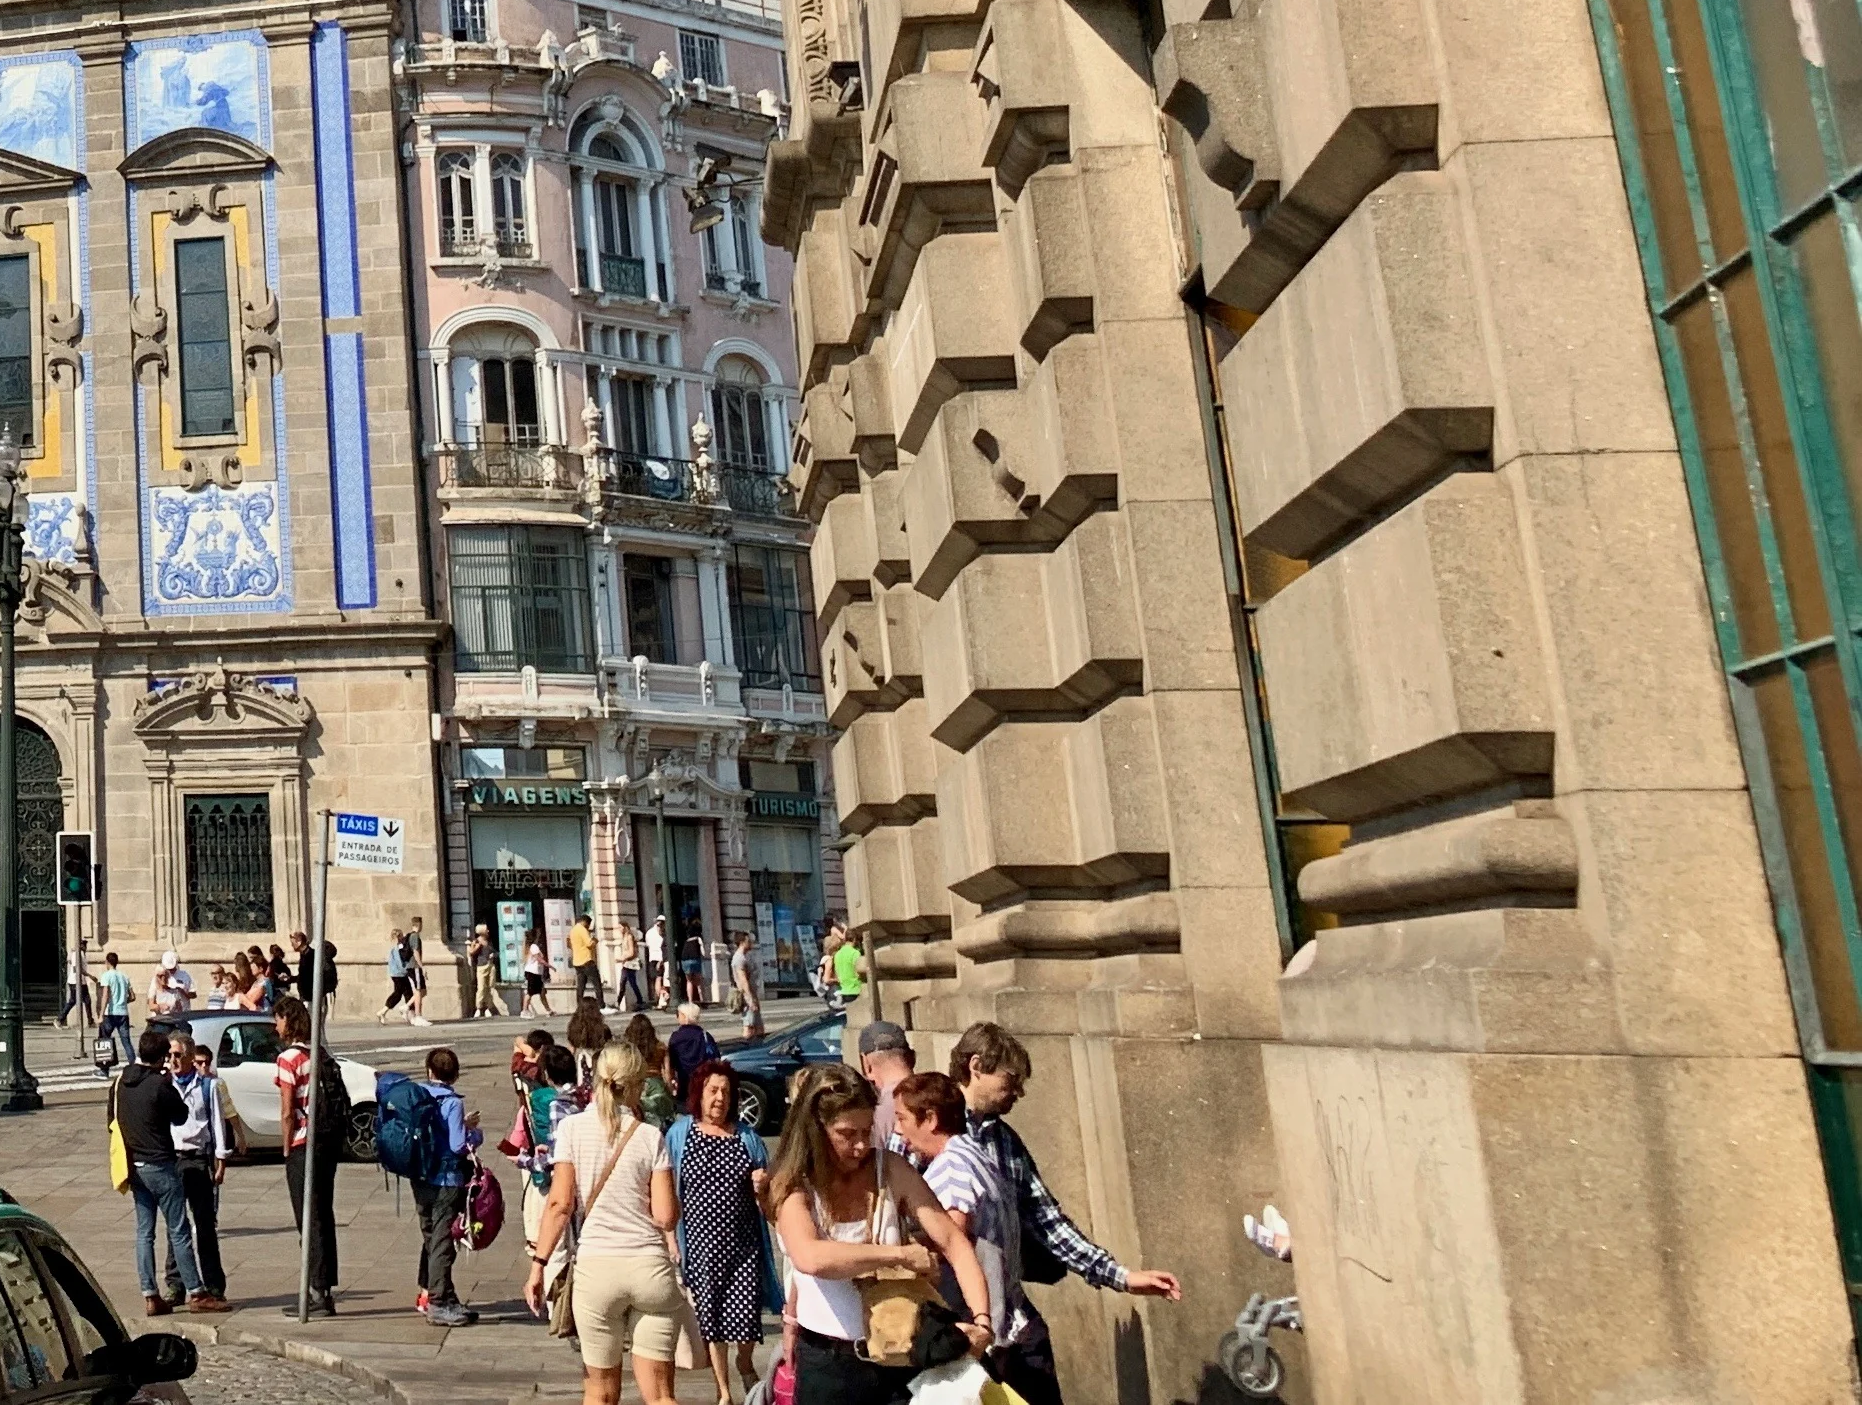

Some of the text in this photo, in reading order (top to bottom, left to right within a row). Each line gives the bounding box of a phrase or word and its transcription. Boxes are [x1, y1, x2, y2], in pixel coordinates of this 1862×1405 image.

[472, 786, 587, 805] VIAGENS
[751, 798, 818, 817] TURISMO
[340, 816, 376, 832] TÁXIS
[341, 841, 398, 854] ENTRADA DE
[338, 851, 400, 866] PASSAGEIROS
[94, 1040, 111, 1051] LER
